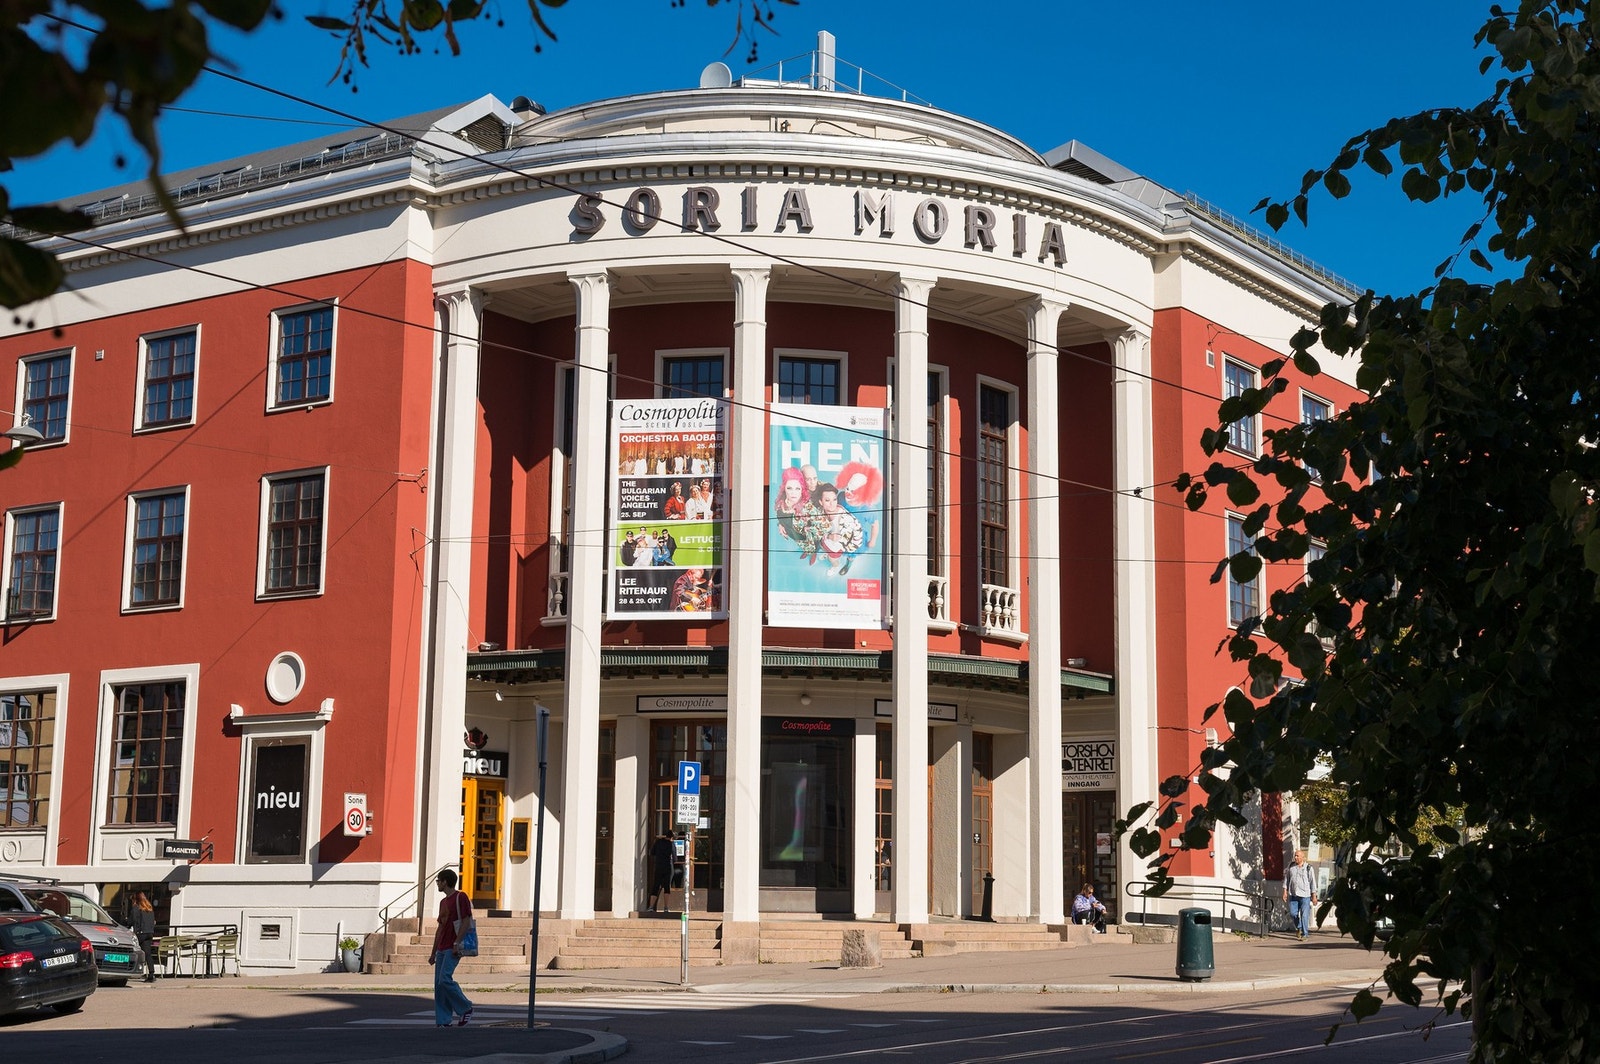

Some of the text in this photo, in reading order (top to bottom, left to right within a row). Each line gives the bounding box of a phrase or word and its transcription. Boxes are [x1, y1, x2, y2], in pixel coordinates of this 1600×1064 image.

[572, 186, 1069, 266] SORIA MORIA
[620, 401, 724, 427] Cosmopolite
[621, 433, 724, 443] ORCHESTRA BAOBAB
[781, 441, 879, 472] HEN
[621, 487, 667, 495] BULGARIAN
[680, 535, 721, 543] LETTUCE
[620, 578, 637, 586] LEE
[620, 587, 667, 595] RITENAUR
[655, 697, 714, 709] Cosmopolite
[782, 720, 831, 734] Cosmopolite
[463, 751, 501, 775] nieu
[1072, 757, 1115, 771] TEATRET
[684, 766, 695, 790] P
[257, 785, 300, 809] nieu
[347, 796, 364, 805] Sone
[350, 814, 361, 826] 30
